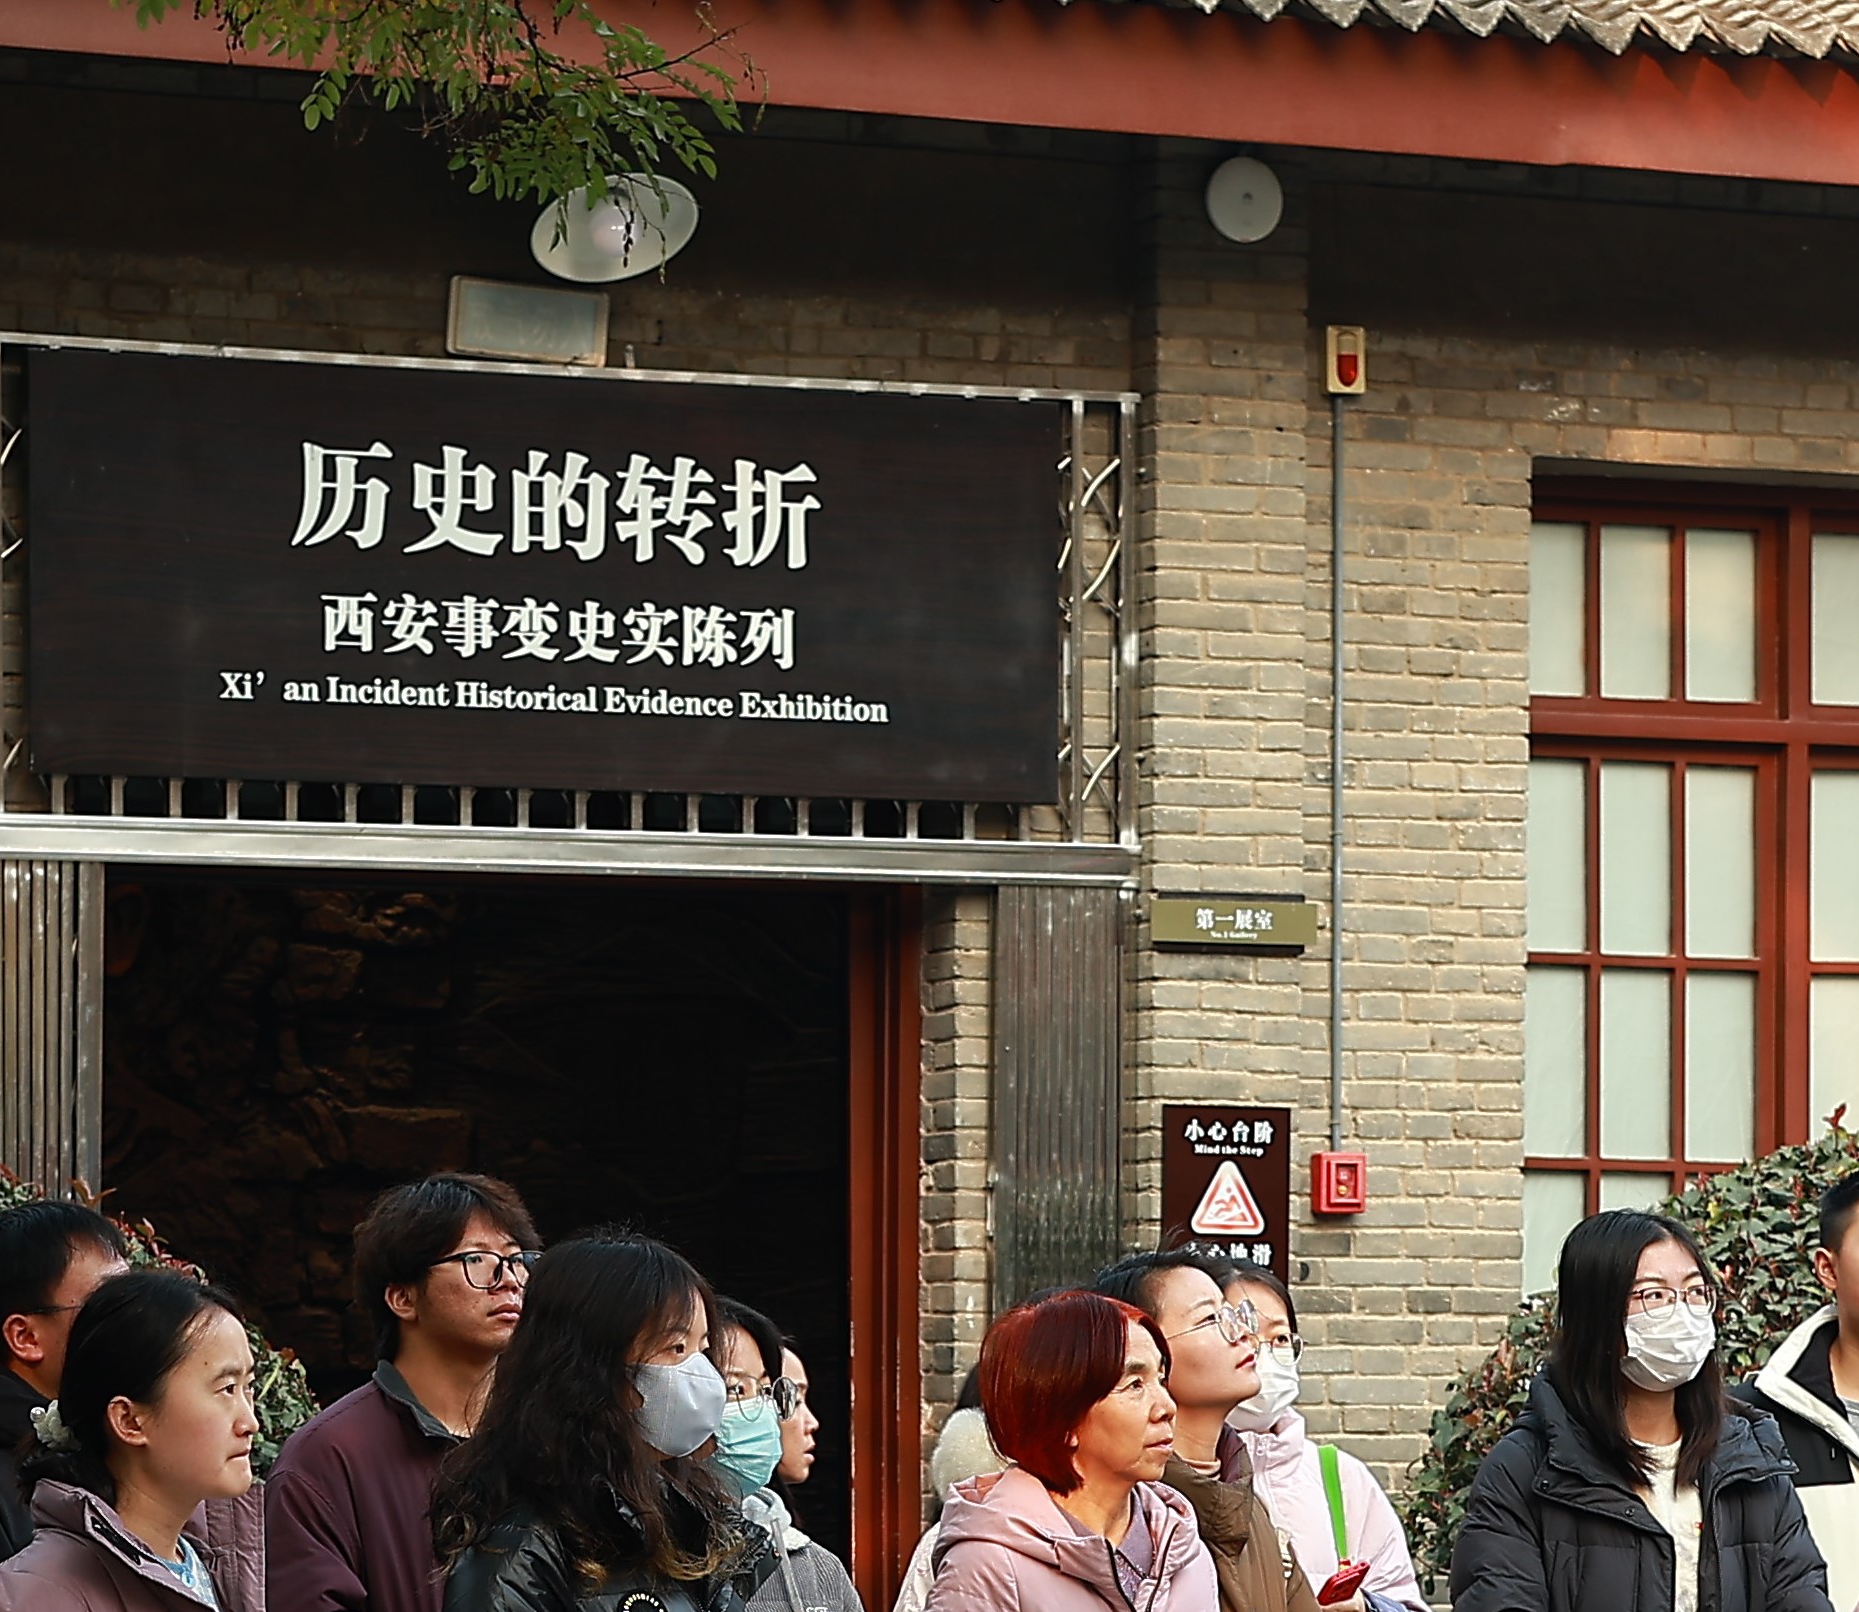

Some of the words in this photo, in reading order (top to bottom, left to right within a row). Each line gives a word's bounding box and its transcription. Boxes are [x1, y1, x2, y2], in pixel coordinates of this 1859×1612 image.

[290, 440, 822, 570] 历史的转折
[319, 592, 796, 670] 西安事变史实陈列
[283, 682, 321, 702] an
[326, 676, 451, 707] Incident
[454, 681, 599, 712] Historical
[603, 686, 734, 717] Evidence
[739, 691, 890, 723] Exhibition
[1195, 907, 1274, 931] 第一展室
[1184, 1118, 1274, 1144] 小心台阶
[1194, 1143, 1220, 1155] Mind
[1221, 1144, 1239, 1155] the
[1239, 1144, 1264, 1157] Step
